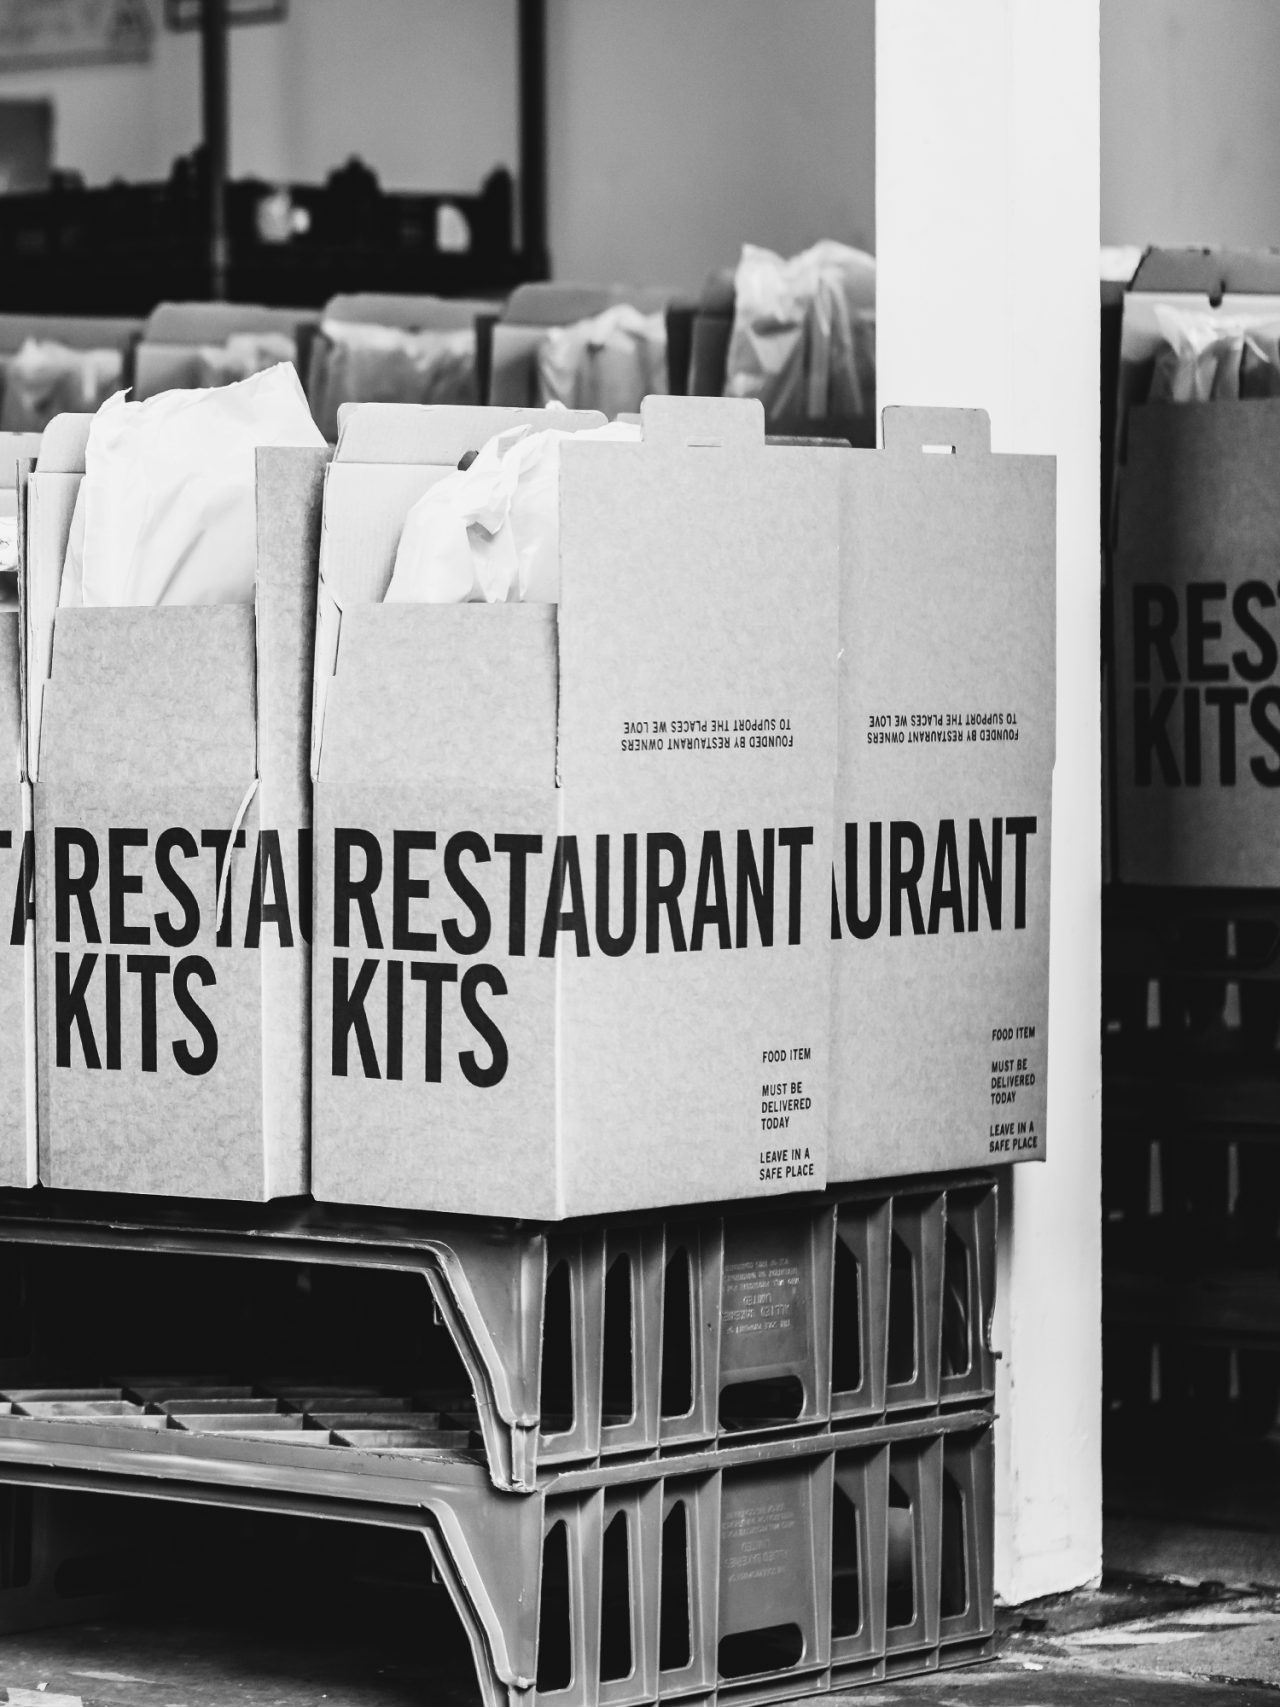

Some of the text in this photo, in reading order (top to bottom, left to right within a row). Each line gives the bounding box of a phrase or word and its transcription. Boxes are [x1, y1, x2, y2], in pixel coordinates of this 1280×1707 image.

[1132, 580, 1280, 682] RES
[624, 718, 791, 734] TO SUPPORT THE PLACES WE LOVE
[869, 712, 1017, 728] TO SUPPORT THE PLACES WE LOVE
[621, 735, 794, 751] FOUNDED BY RESTAURANT OWNERS
[867, 728, 1019, 744] FOUNDED BY RESTAURANT OWNERS
[1132, 685, 1280, 788] KITS
[831, 816, 1037, 940] URANT
[333, 826, 814, 958] RESTAURANT
[55, 951, 219, 1076] KITS
[331, 957, 509, 1089] KITS
[992, 1026, 1036, 1041] FOOD ITEM
[762, 1048, 811, 1063] FOOD ITEM
[991, 1058, 1028, 1073] MUST BE
[762, 1081, 802, 1097] MUST BE
[991, 1073, 1036, 1089] DELIVERED
[990, 1090, 1016, 1105] TODAY
[761, 1098, 811, 1114] DELIVERED
[761, 1117, 790, 1130] TODAY
[990, 1121, 1034, 1137] LEAVE IN A
[989, 1136, 1038, 1153] SAFE PLACE
[760, 1147, 810, 1164] LEAVE IN A
[760, 1164, 814, 1181] SAFE PLACE
